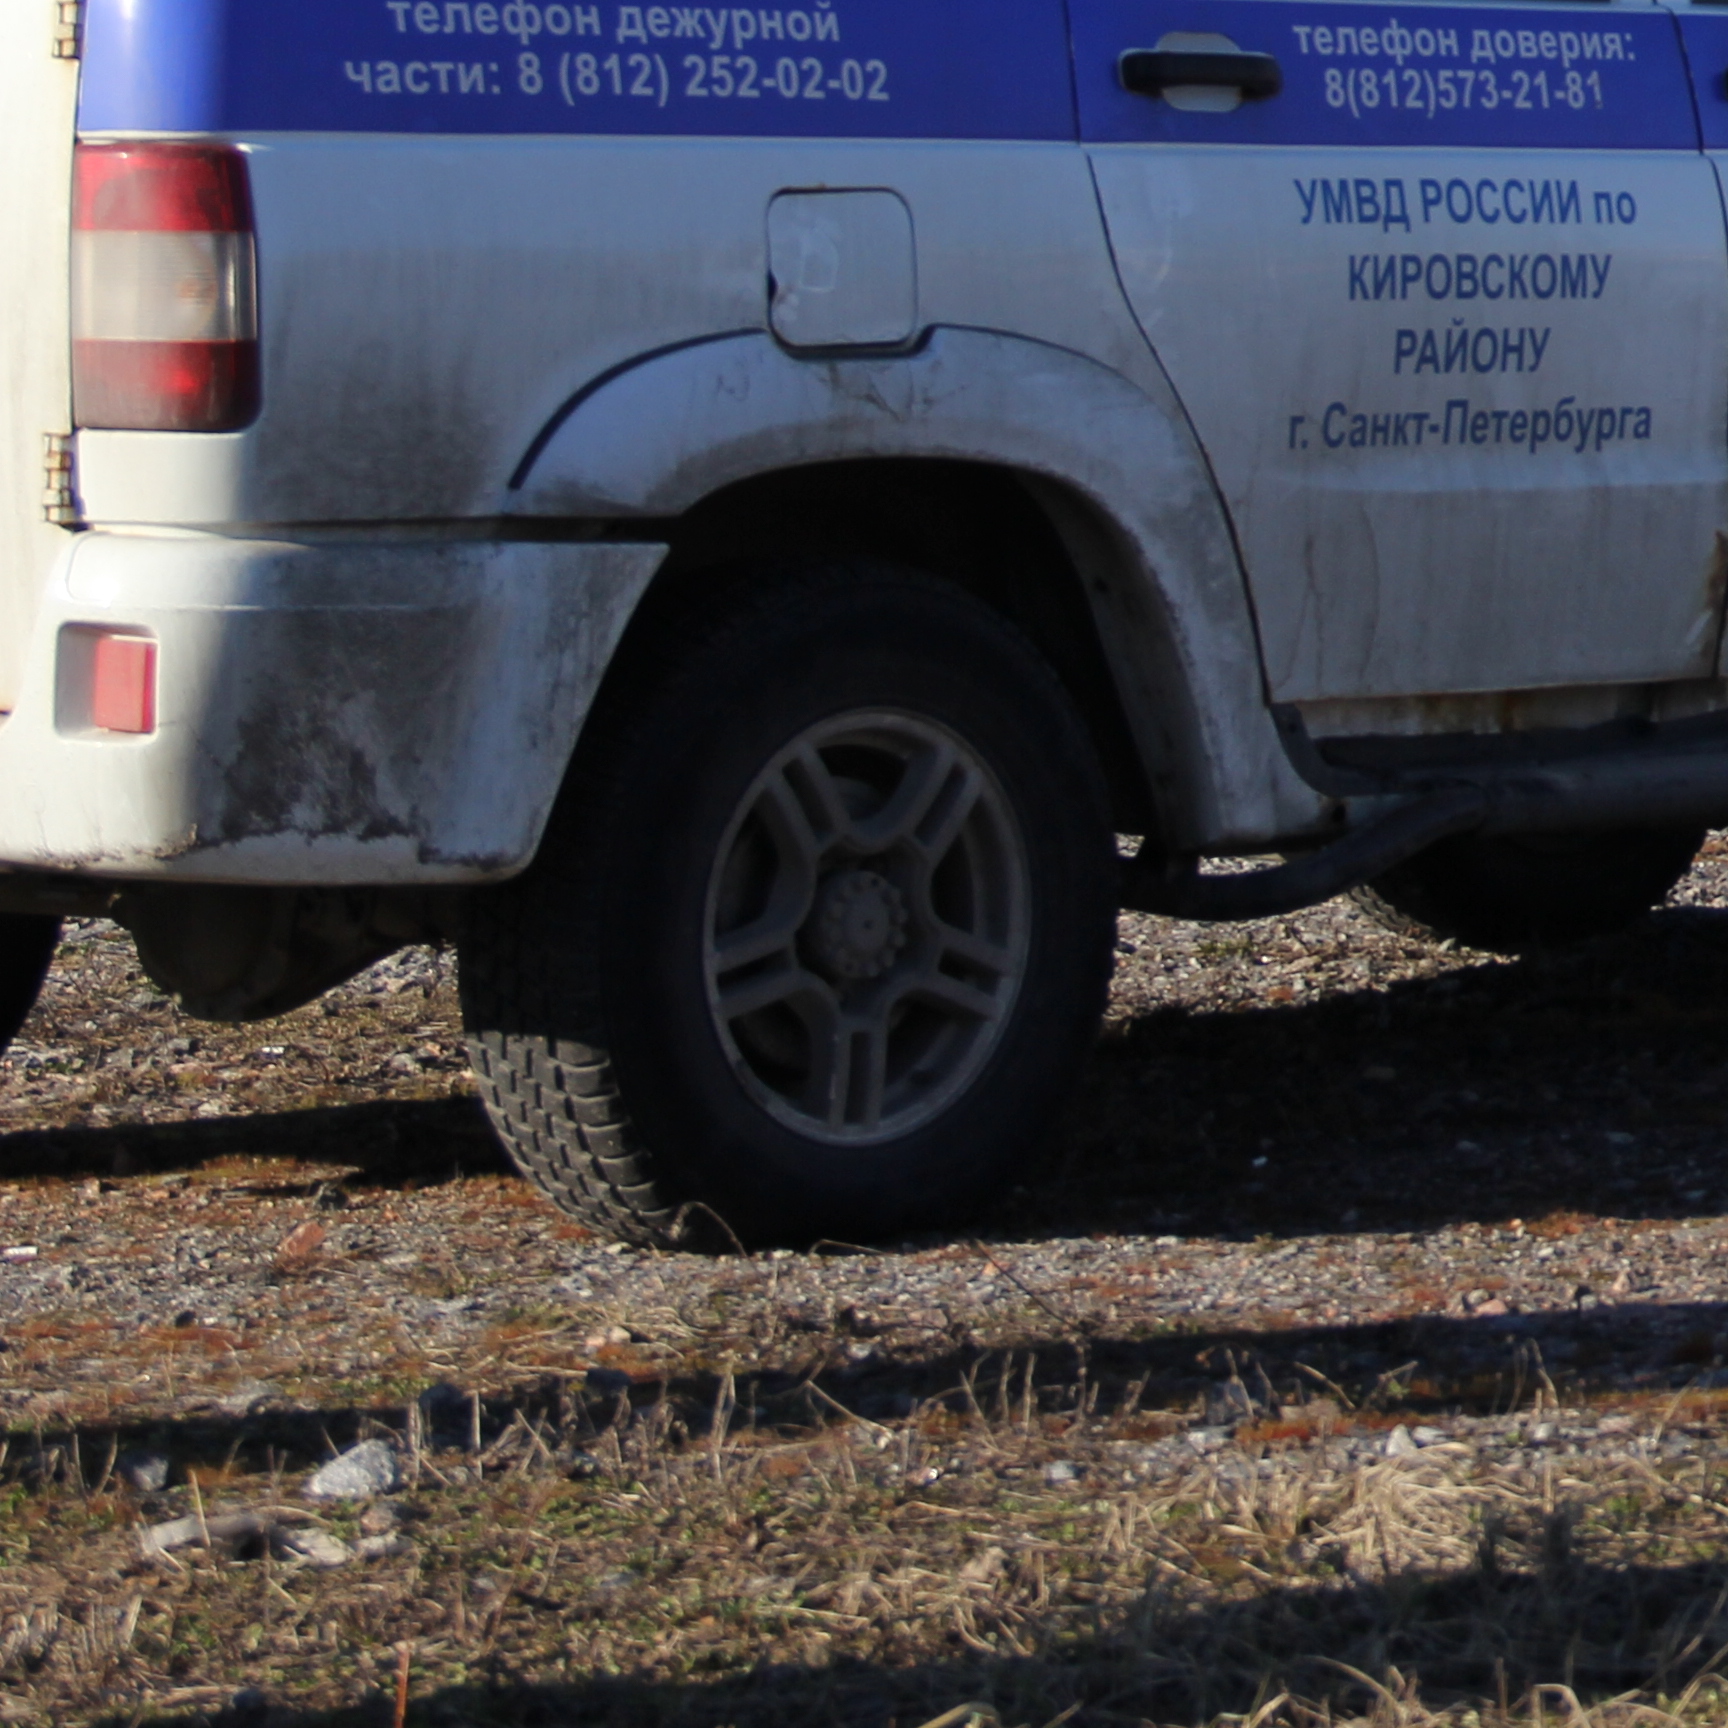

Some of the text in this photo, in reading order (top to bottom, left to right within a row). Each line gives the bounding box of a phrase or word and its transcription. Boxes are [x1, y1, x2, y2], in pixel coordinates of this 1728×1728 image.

[615, 1, 841, 49] дежурной
[1293, 21, 1637, 67] телефон доверия:
[344, 53, 890, 107] части: 8 (812) 252-02-02
[1323, 69, 1604, 120] 8(812)573-21-81
[1294, 177, 1637, 233] УМВД РОССИИ по
[1347, 252, 1612, 302] КИРОВСКОМУ
[1394, 320, 1551, 376] РАЙОНУ
[1288, 394, 1653, 455] г. Санкт-Петербурга
